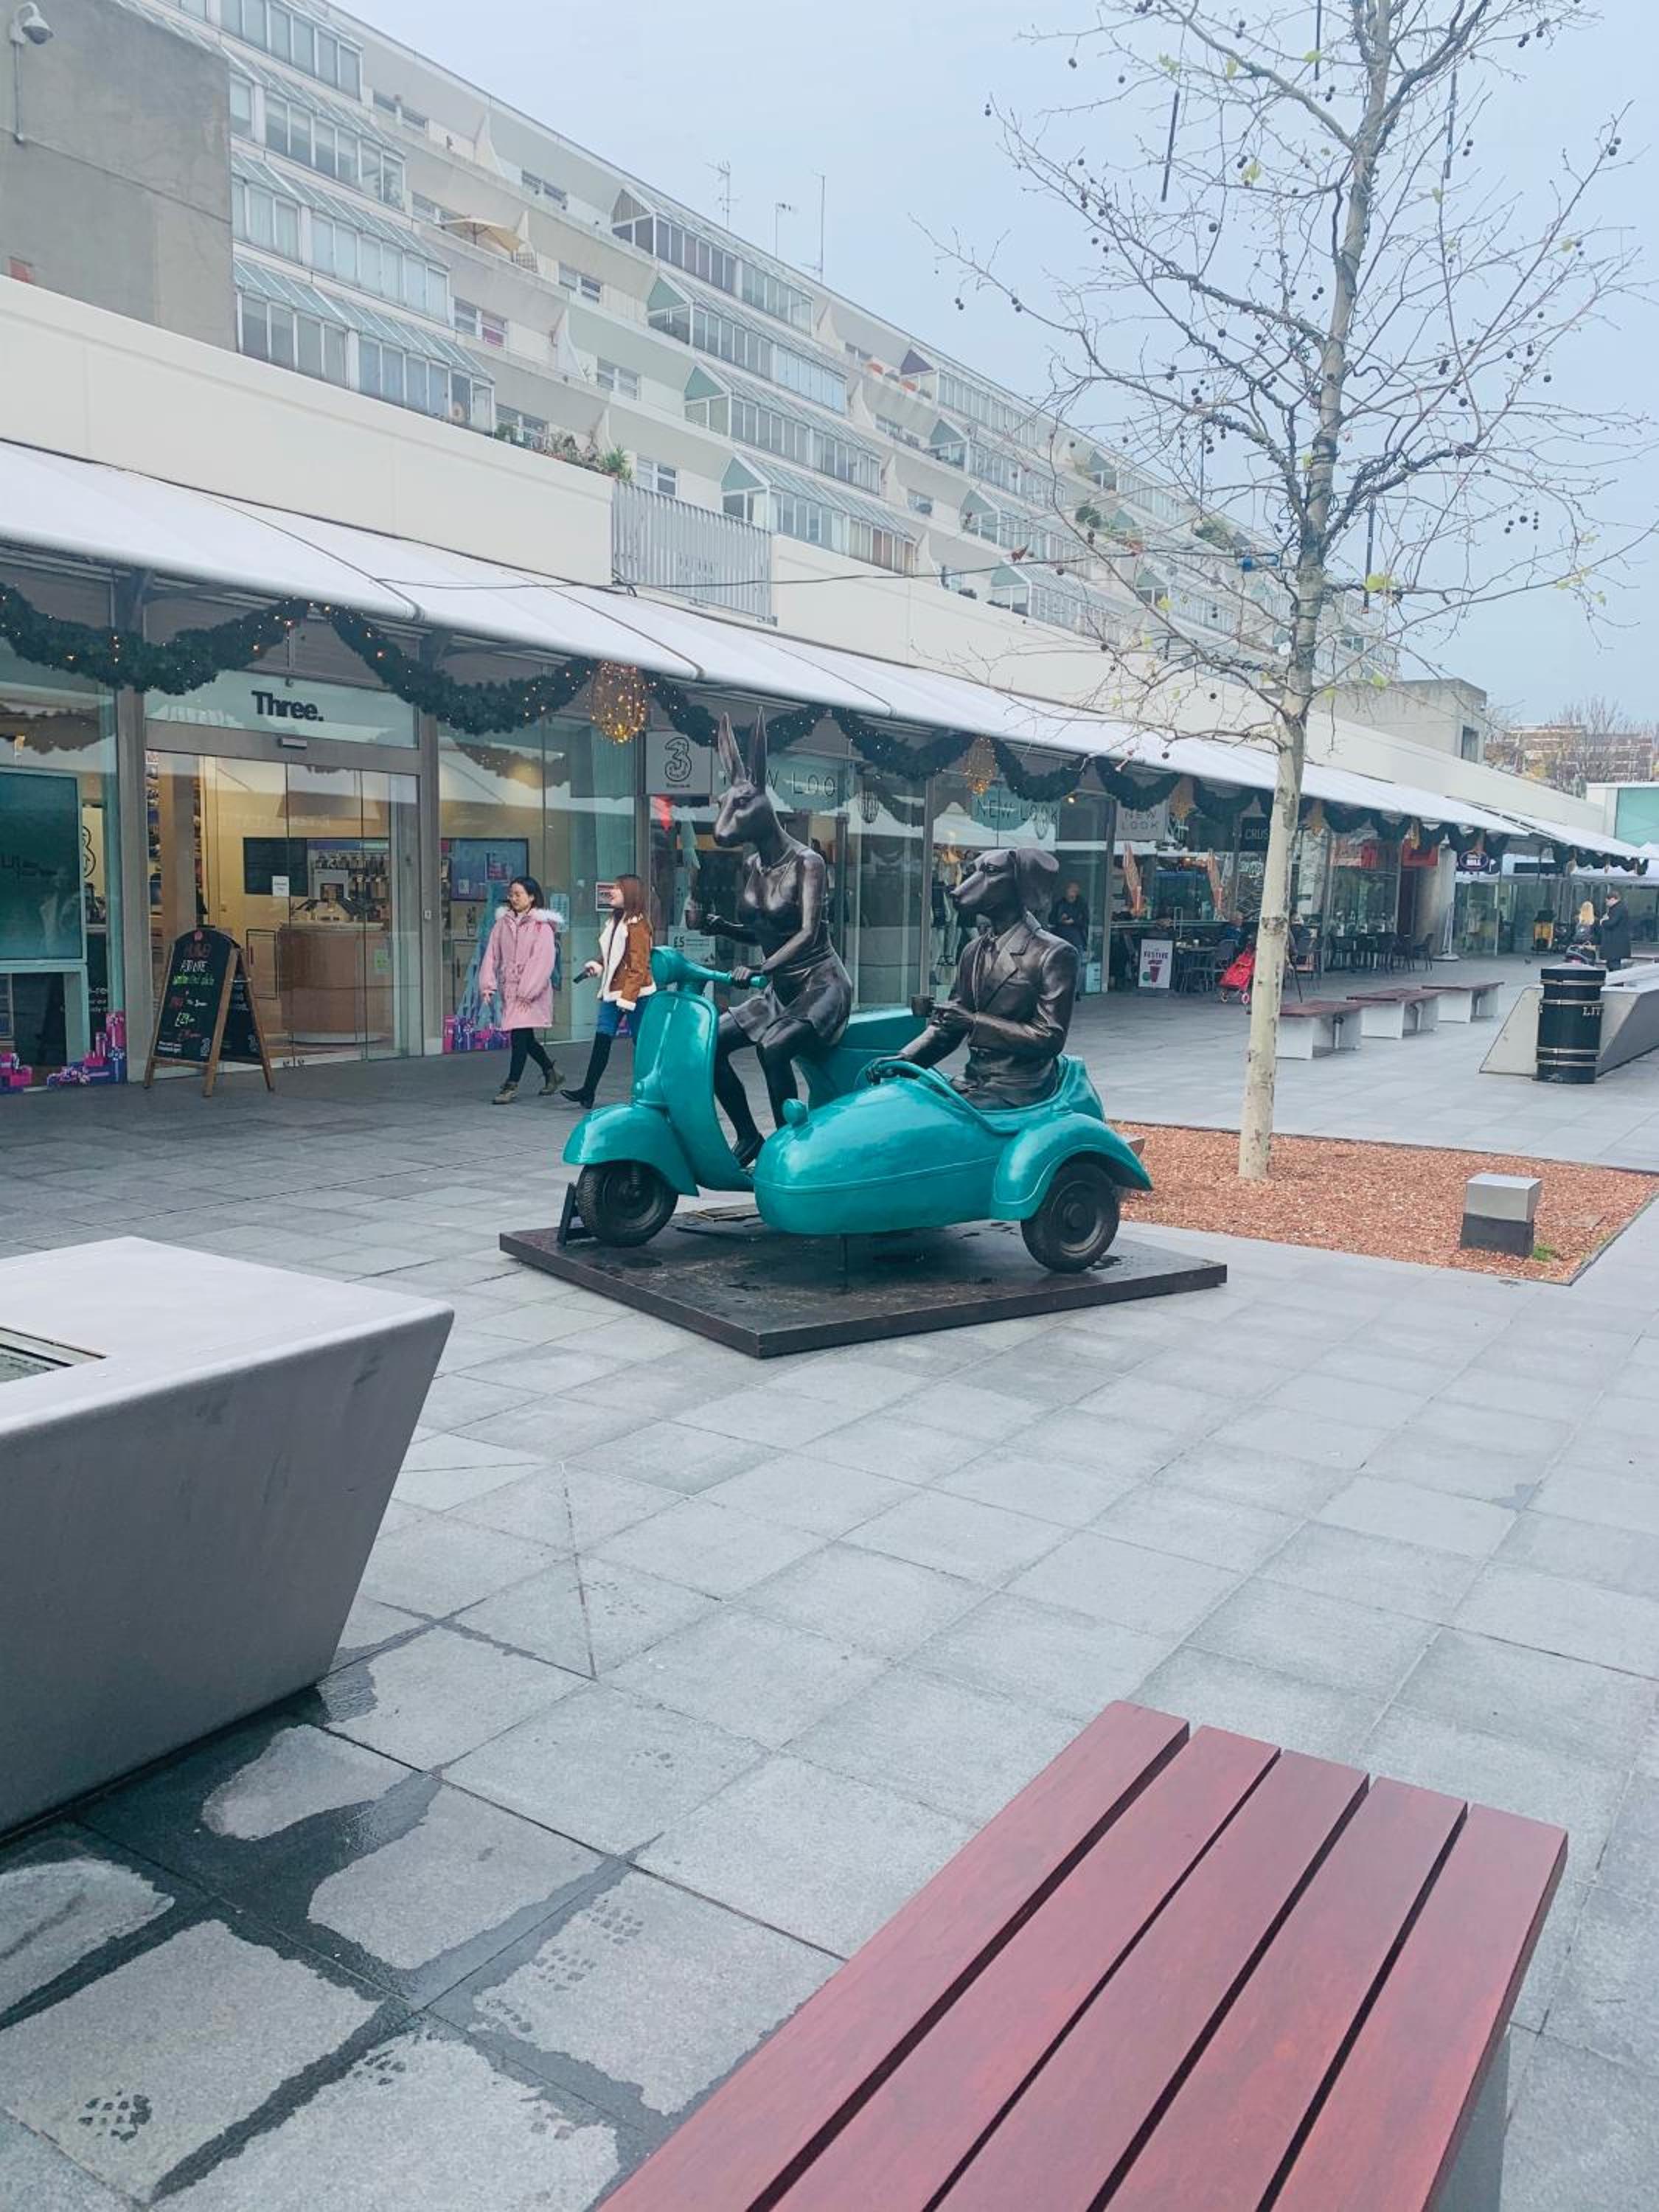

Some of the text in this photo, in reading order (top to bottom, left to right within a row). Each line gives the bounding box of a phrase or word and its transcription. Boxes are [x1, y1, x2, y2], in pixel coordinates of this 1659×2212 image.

[251, 690, 324, 721] Three.
[664, 737, 693, 782] 3
[792, 771, 835, 797] LOO
[976, 799, 1058, 823] NEW LOOK
[1124, 811, 1156, 819] NEW
[1121, 820, 1158, 830] LOOK
[1245, 827, 1270, 840] CRUS
